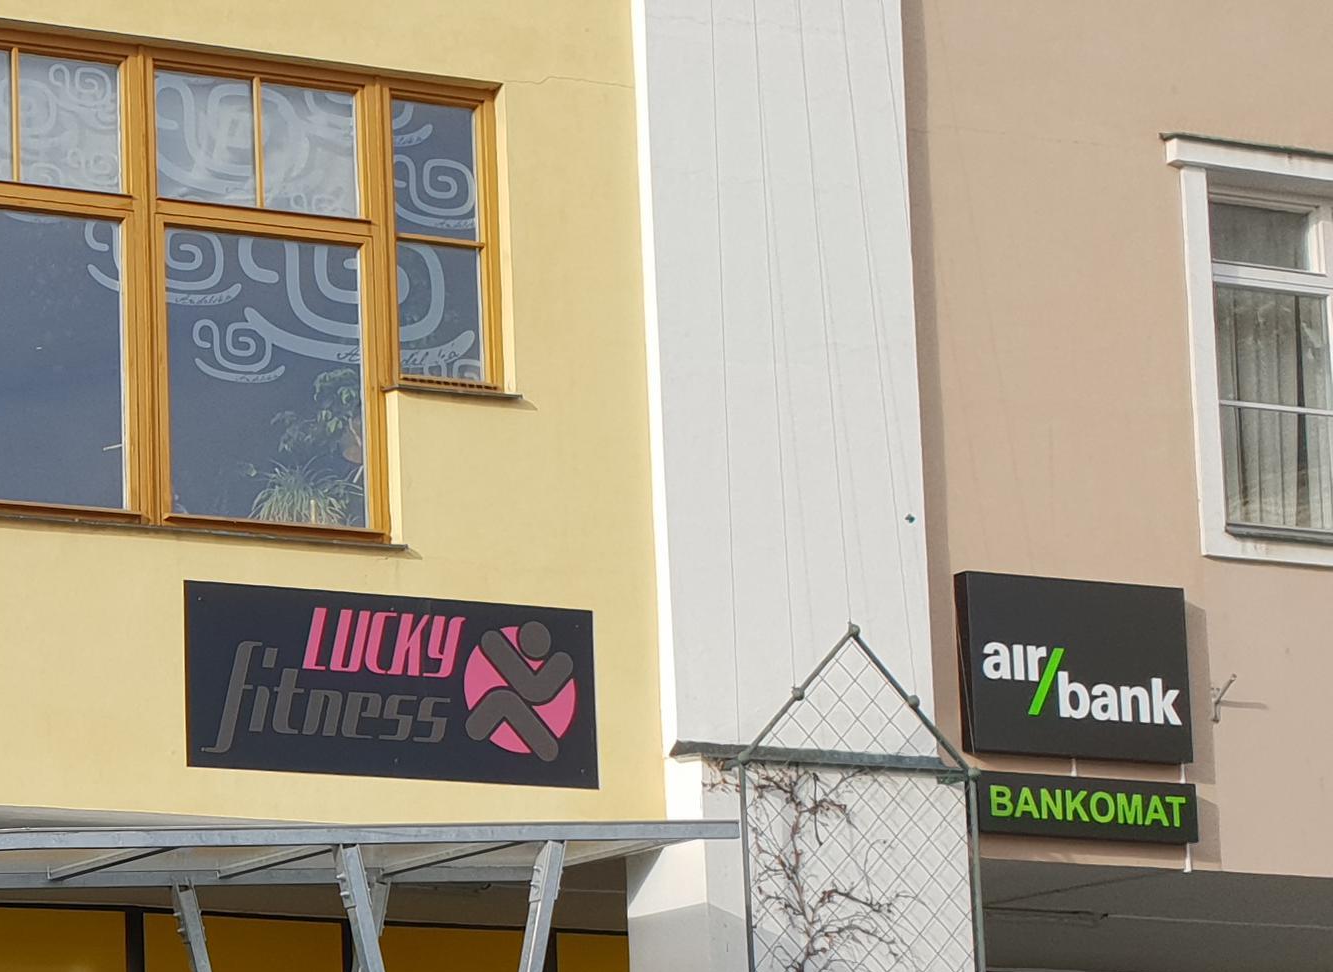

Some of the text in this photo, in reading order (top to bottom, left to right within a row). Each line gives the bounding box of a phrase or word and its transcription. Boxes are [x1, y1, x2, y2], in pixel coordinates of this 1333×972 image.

[301, 607, 467, 678] LUCKY
[200, 640, 451, 753] fitness
[989, 784, 1186, 828] BANKOMAT
